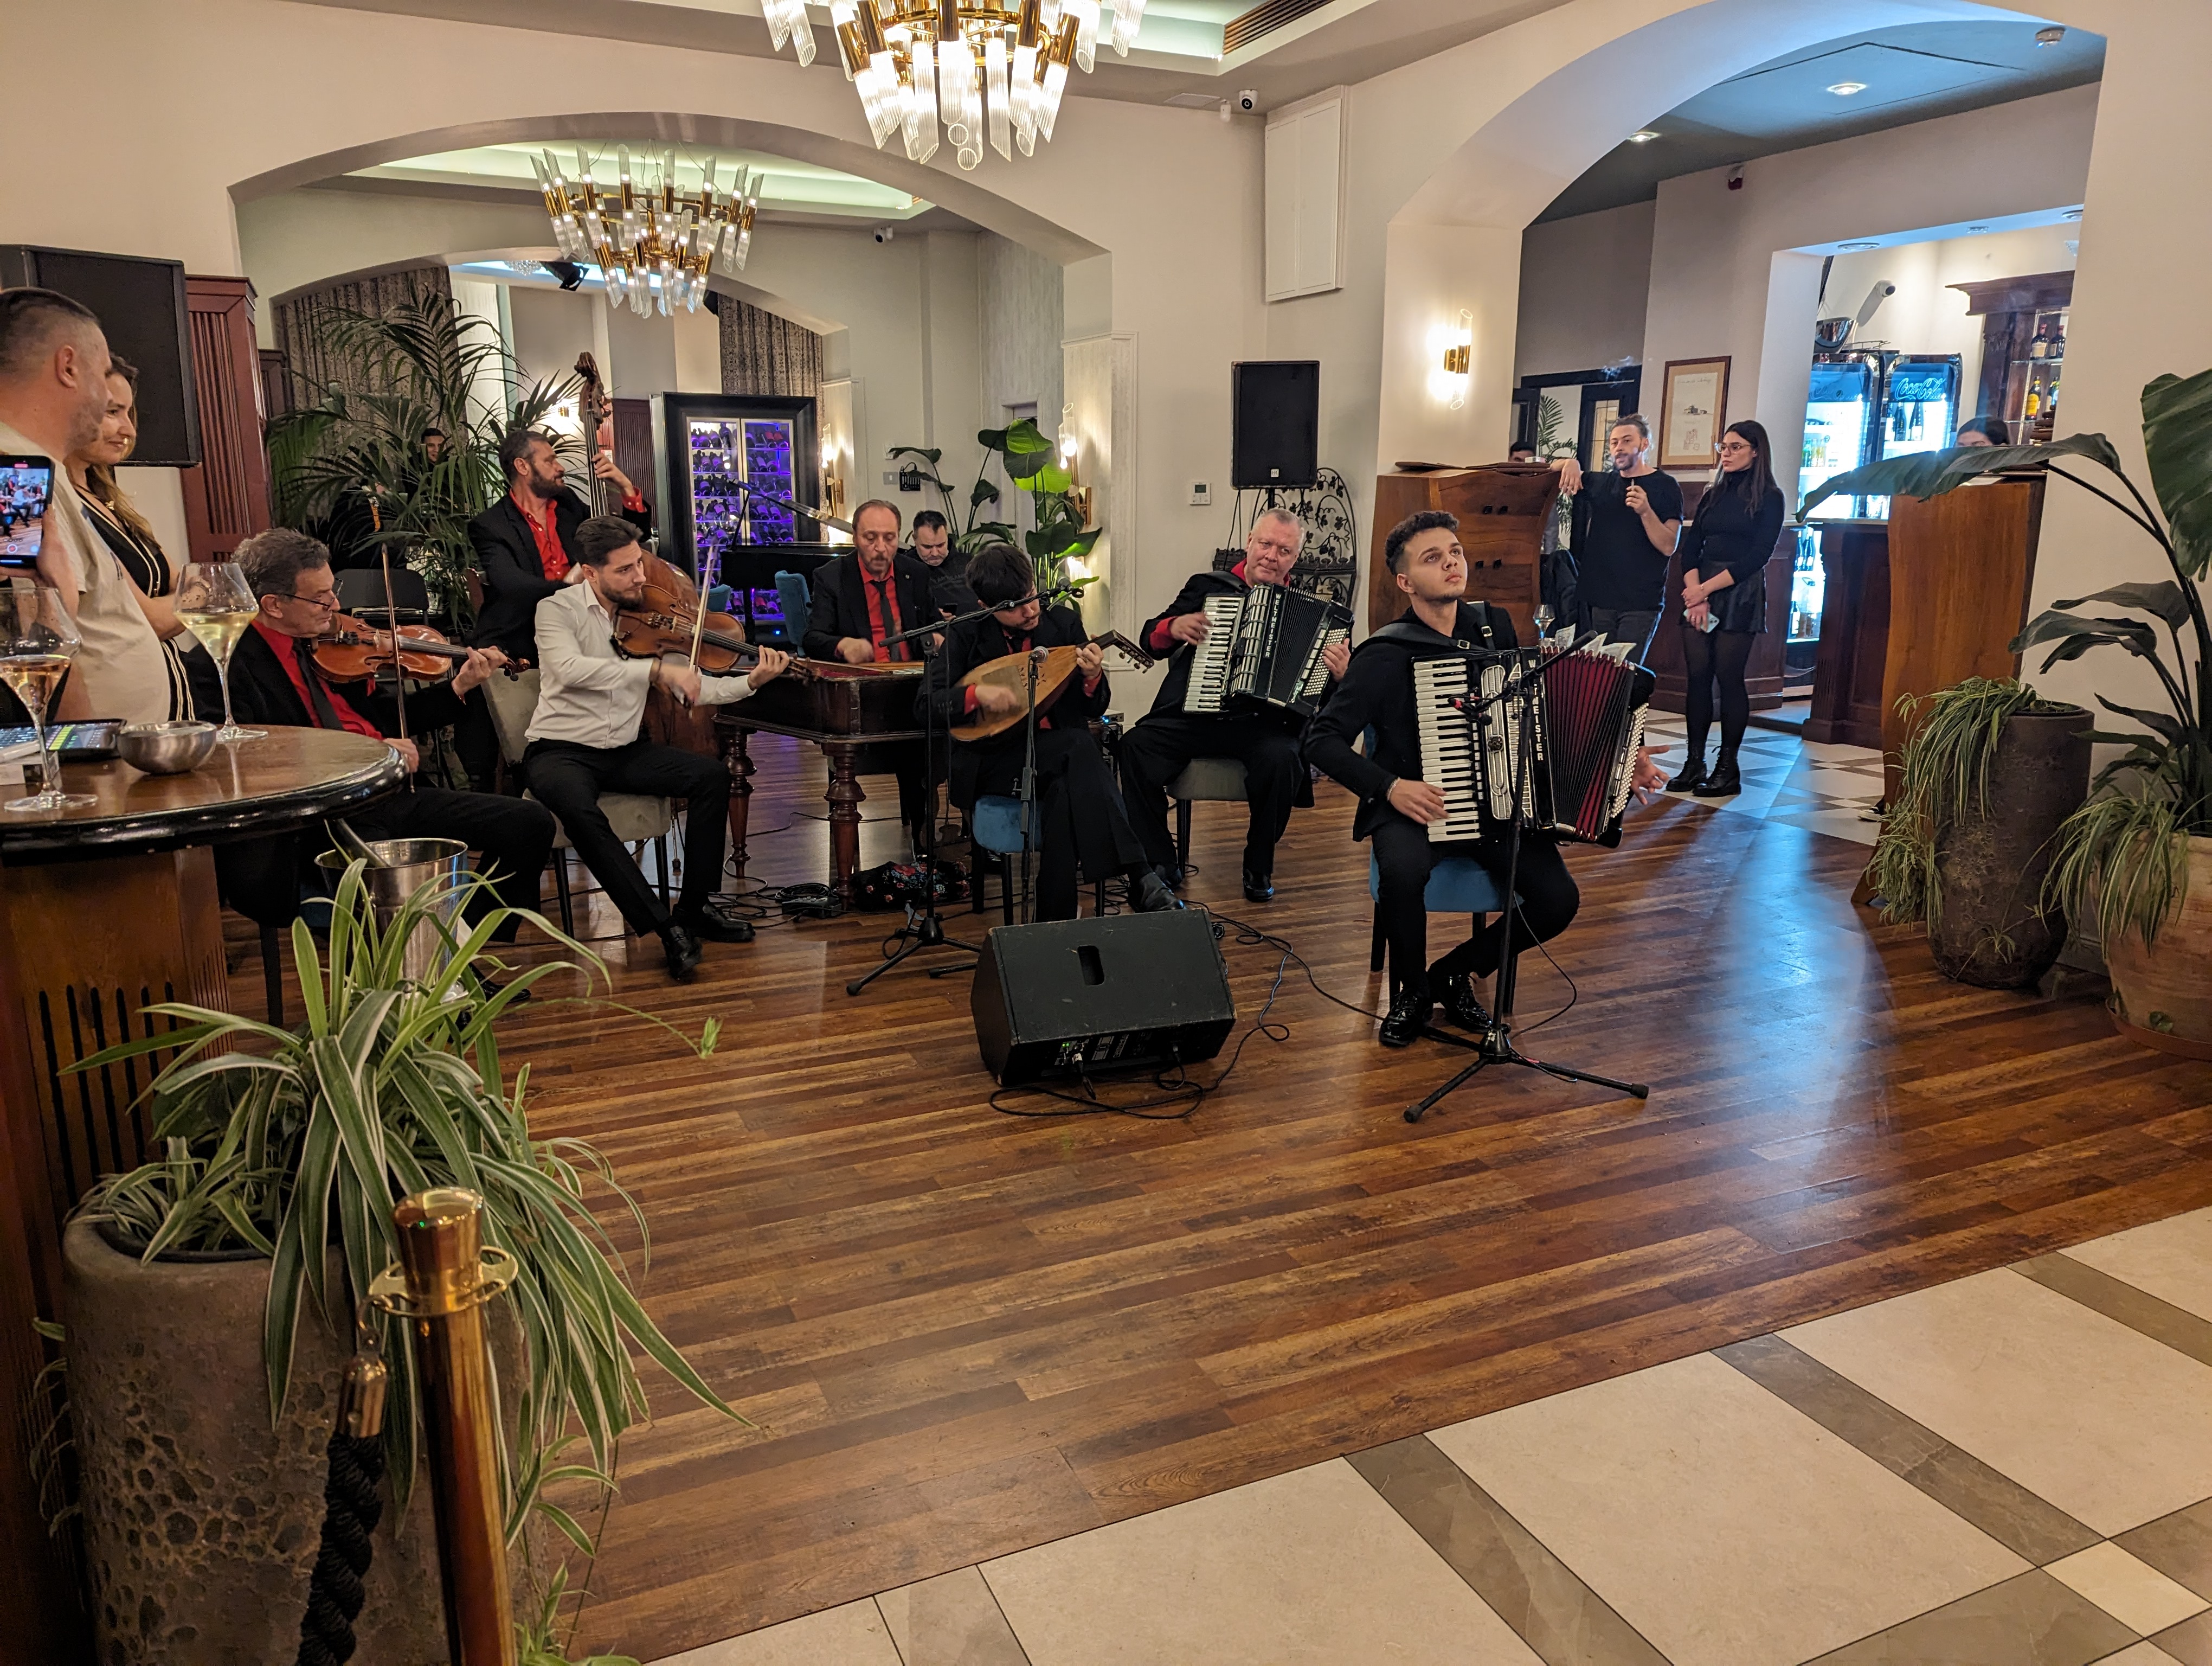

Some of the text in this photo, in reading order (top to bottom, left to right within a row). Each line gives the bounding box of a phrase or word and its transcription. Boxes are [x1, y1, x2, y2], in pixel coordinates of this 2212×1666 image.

[1895, 377, 1945, 400] Coca-Cola
[1265, 593, 1281, 657] WELTMEISTER
[1528, 659, 1543, 761] WTMEISTER
